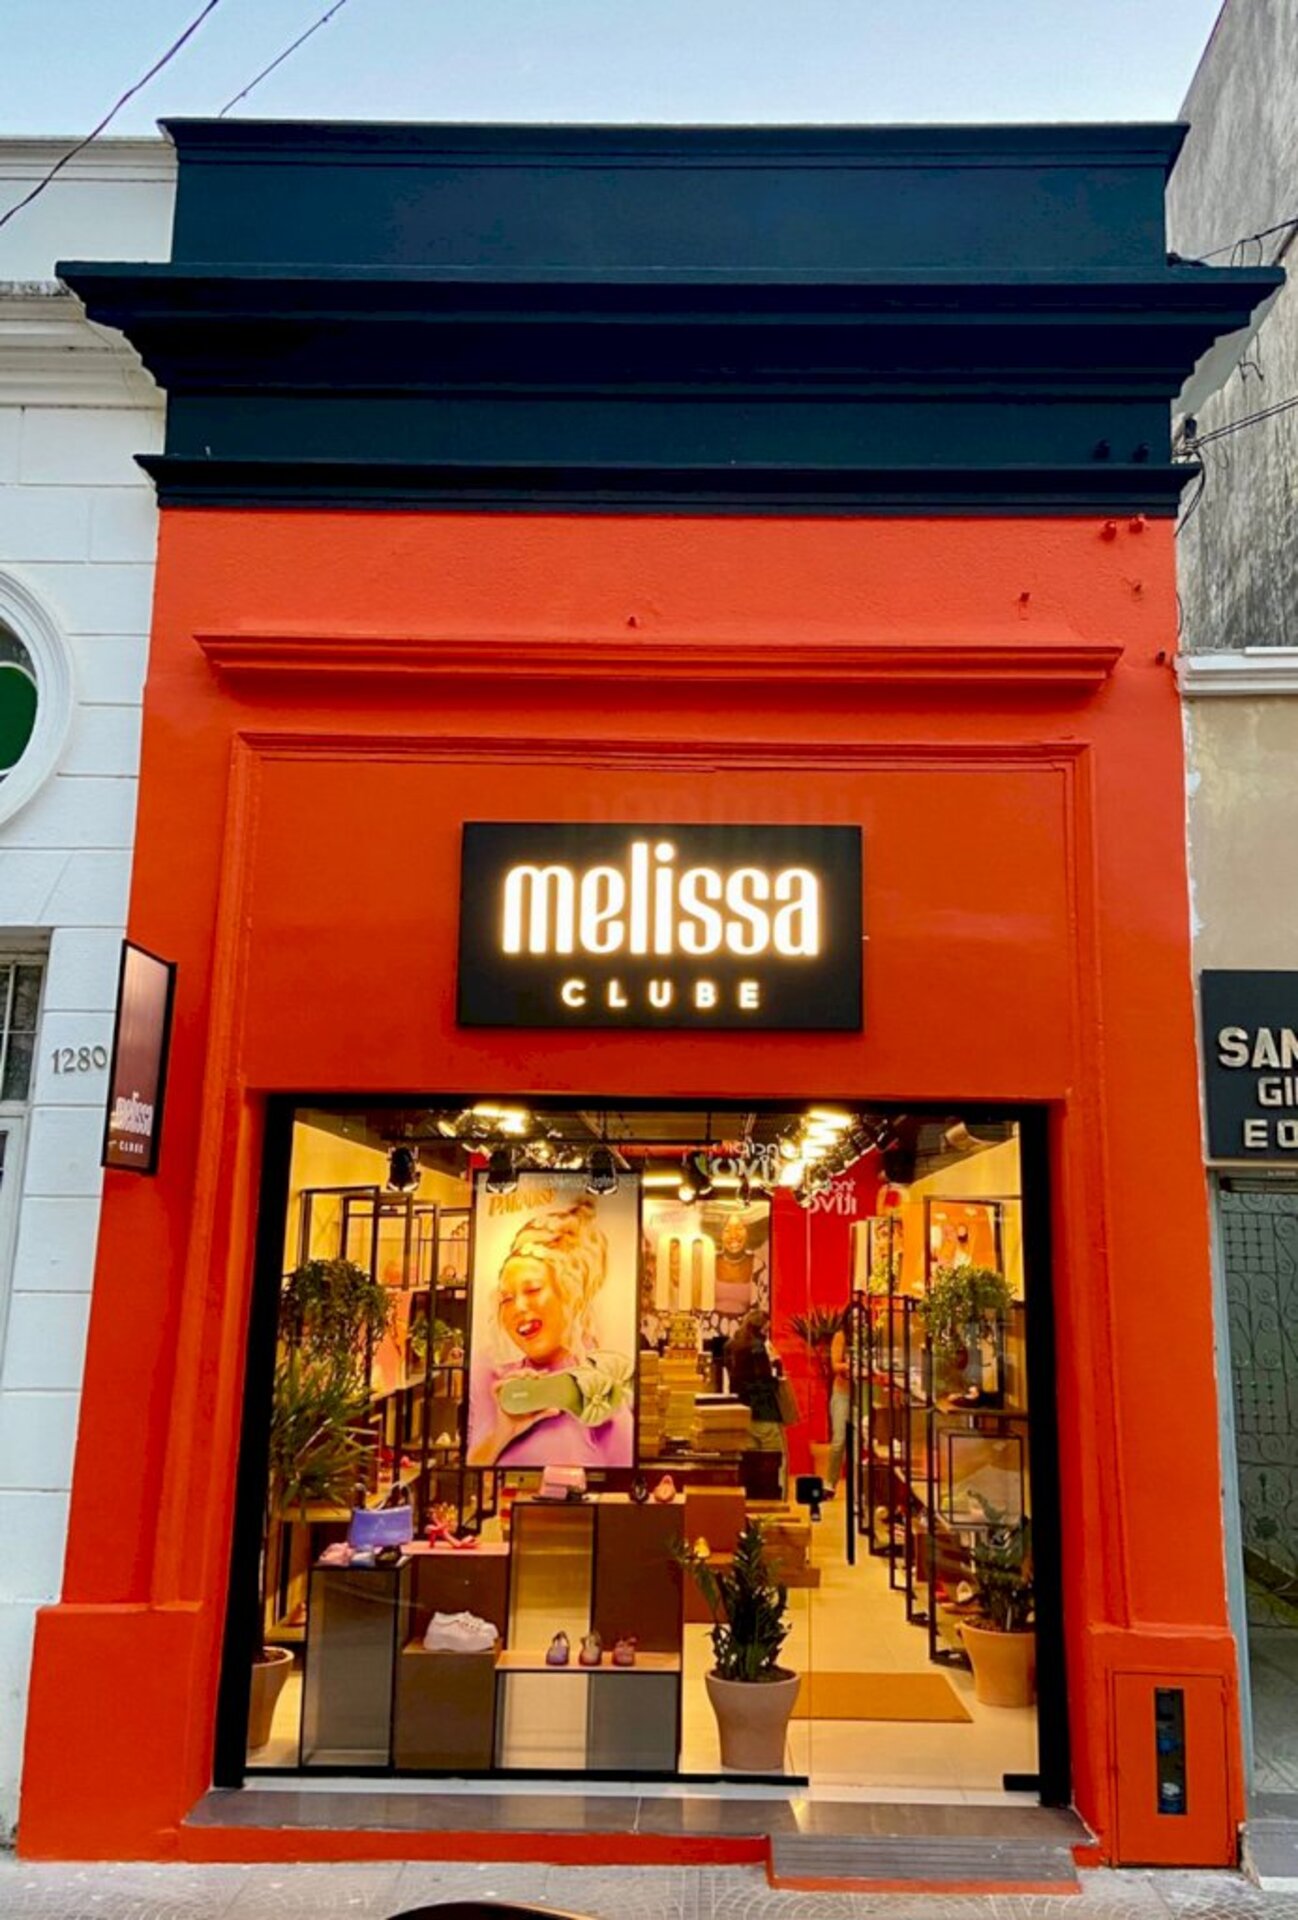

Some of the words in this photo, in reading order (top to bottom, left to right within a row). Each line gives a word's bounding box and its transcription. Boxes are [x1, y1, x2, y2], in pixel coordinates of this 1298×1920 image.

[502, 840, 819, 956] melissa
[561, 980, 760, 1008] CLUBE
[52, 1045, 108, 1075] 1280
